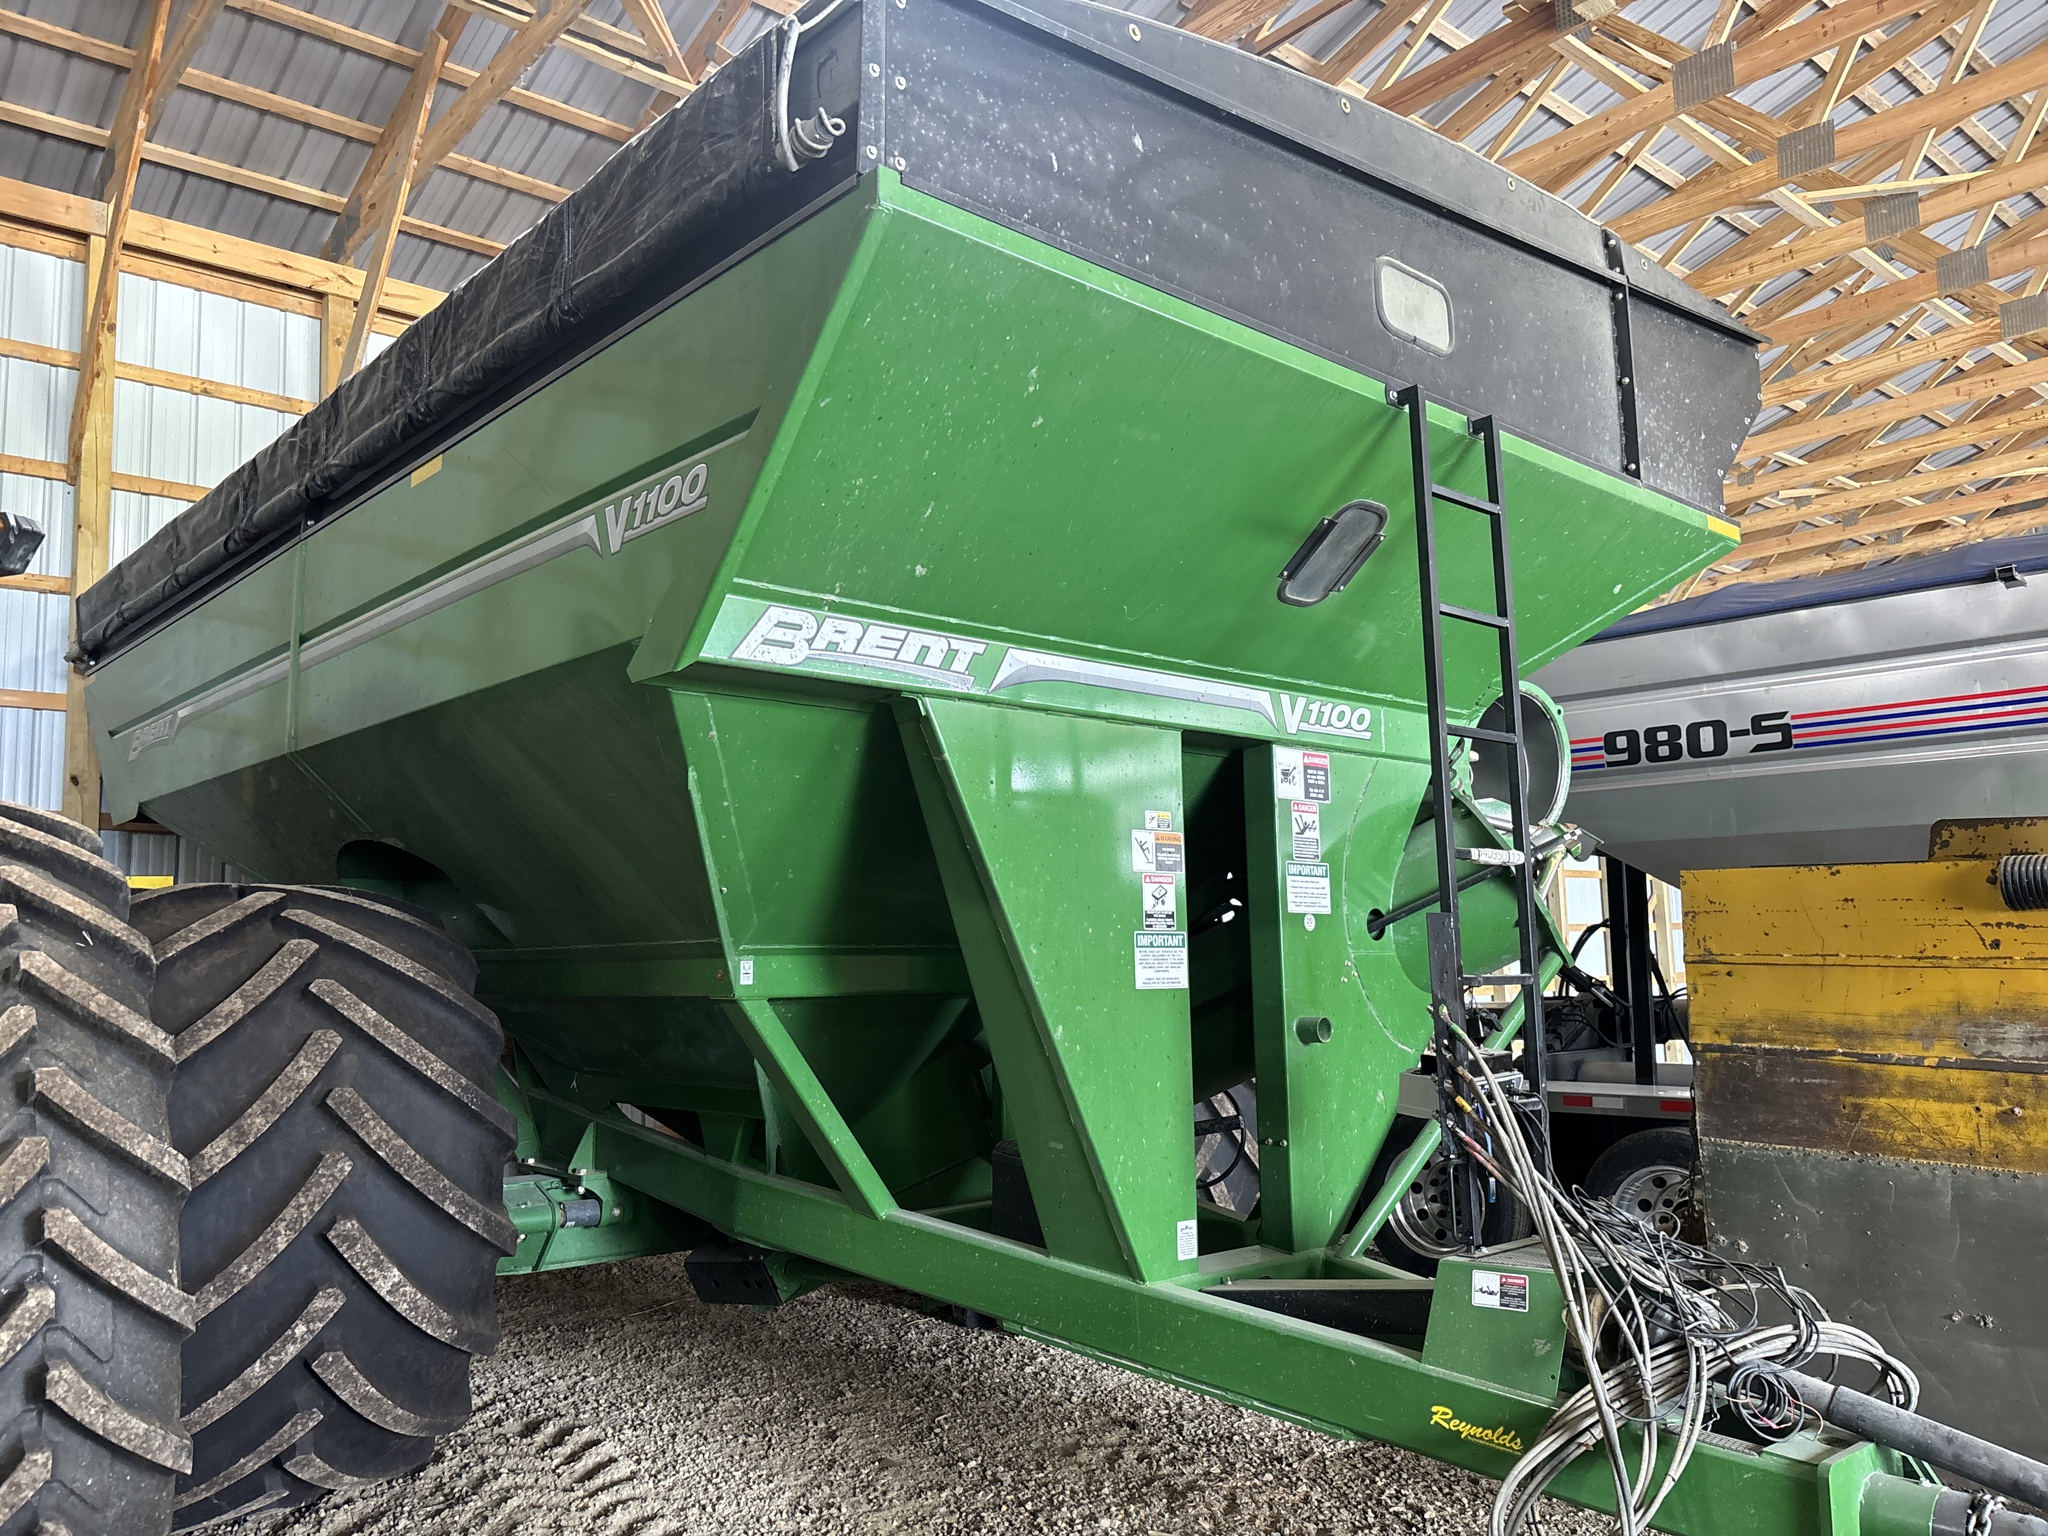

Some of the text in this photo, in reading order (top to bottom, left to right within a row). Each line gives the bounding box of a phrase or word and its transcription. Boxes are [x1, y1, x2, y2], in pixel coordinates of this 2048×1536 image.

[605, 462, 709, 556] V1100
[728, 604, 989, 677] BRENT
[1279, 692, 1372, 736] V1100
[1603, 710, 1793, 768] 980-S
[1308, 755, 1329, 765] DANGER
[1298, 803, 1318, 813] DANGER
[1150, 876, 1173, 884] DANGER
[1288, 863, 1328, 877] IMPORTANT
[1137, 934, 1184, 948] IMPORTANT
[1430, 1405, 1523, 1450] Reynolds
